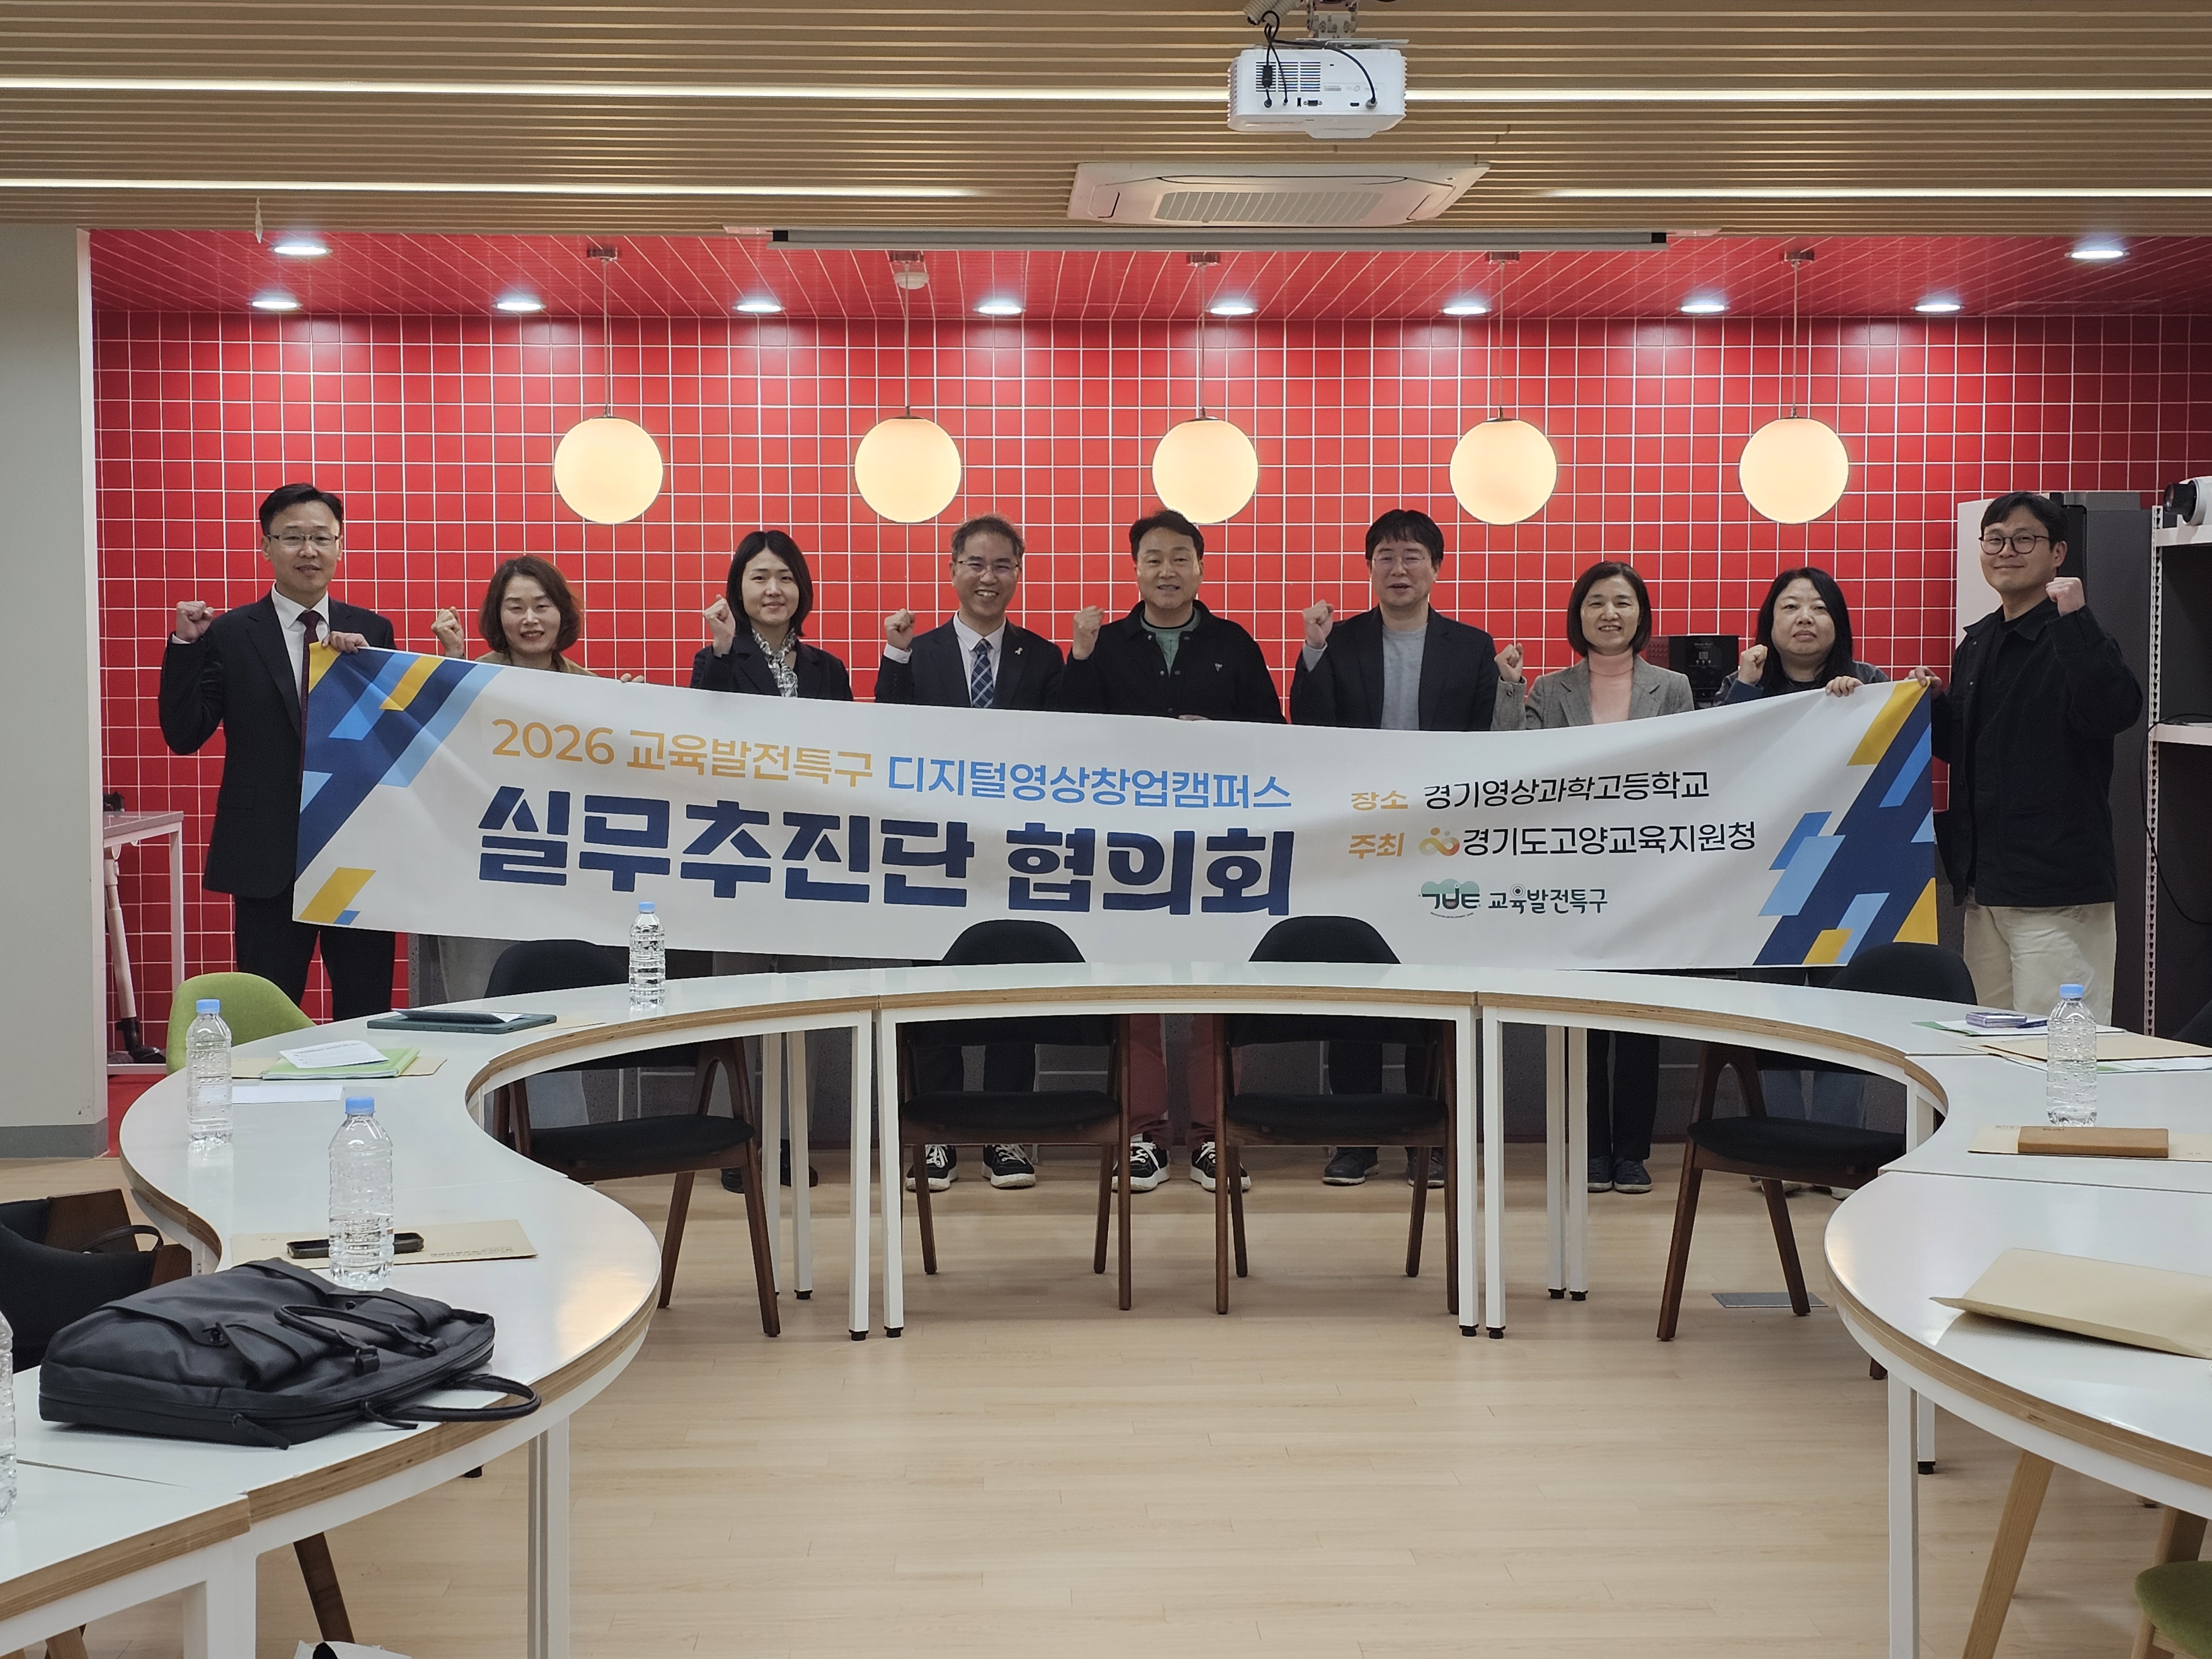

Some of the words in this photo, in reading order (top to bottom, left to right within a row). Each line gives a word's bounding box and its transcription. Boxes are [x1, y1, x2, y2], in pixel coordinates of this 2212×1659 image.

[492, 719, 614, 765] 2026
[627, 729, 872, 787] 교육발전특구
[888, 756, 1292, 809] 디지털영상창업캠퍼스
[1351, 790, 1408, 811] 장소
[1424, 771, 1709, 810] 경기영상과학고등학교
[478, 785, 975, 908] 실무추진단
[1006, 822, 1294, 916] 협의회
[1348, 831, 1404, 859] 주최
[1463, 821, 1756, 856] 경기도고양교육지원청
[1488, 884, 1608, 915] 교육발전특구
